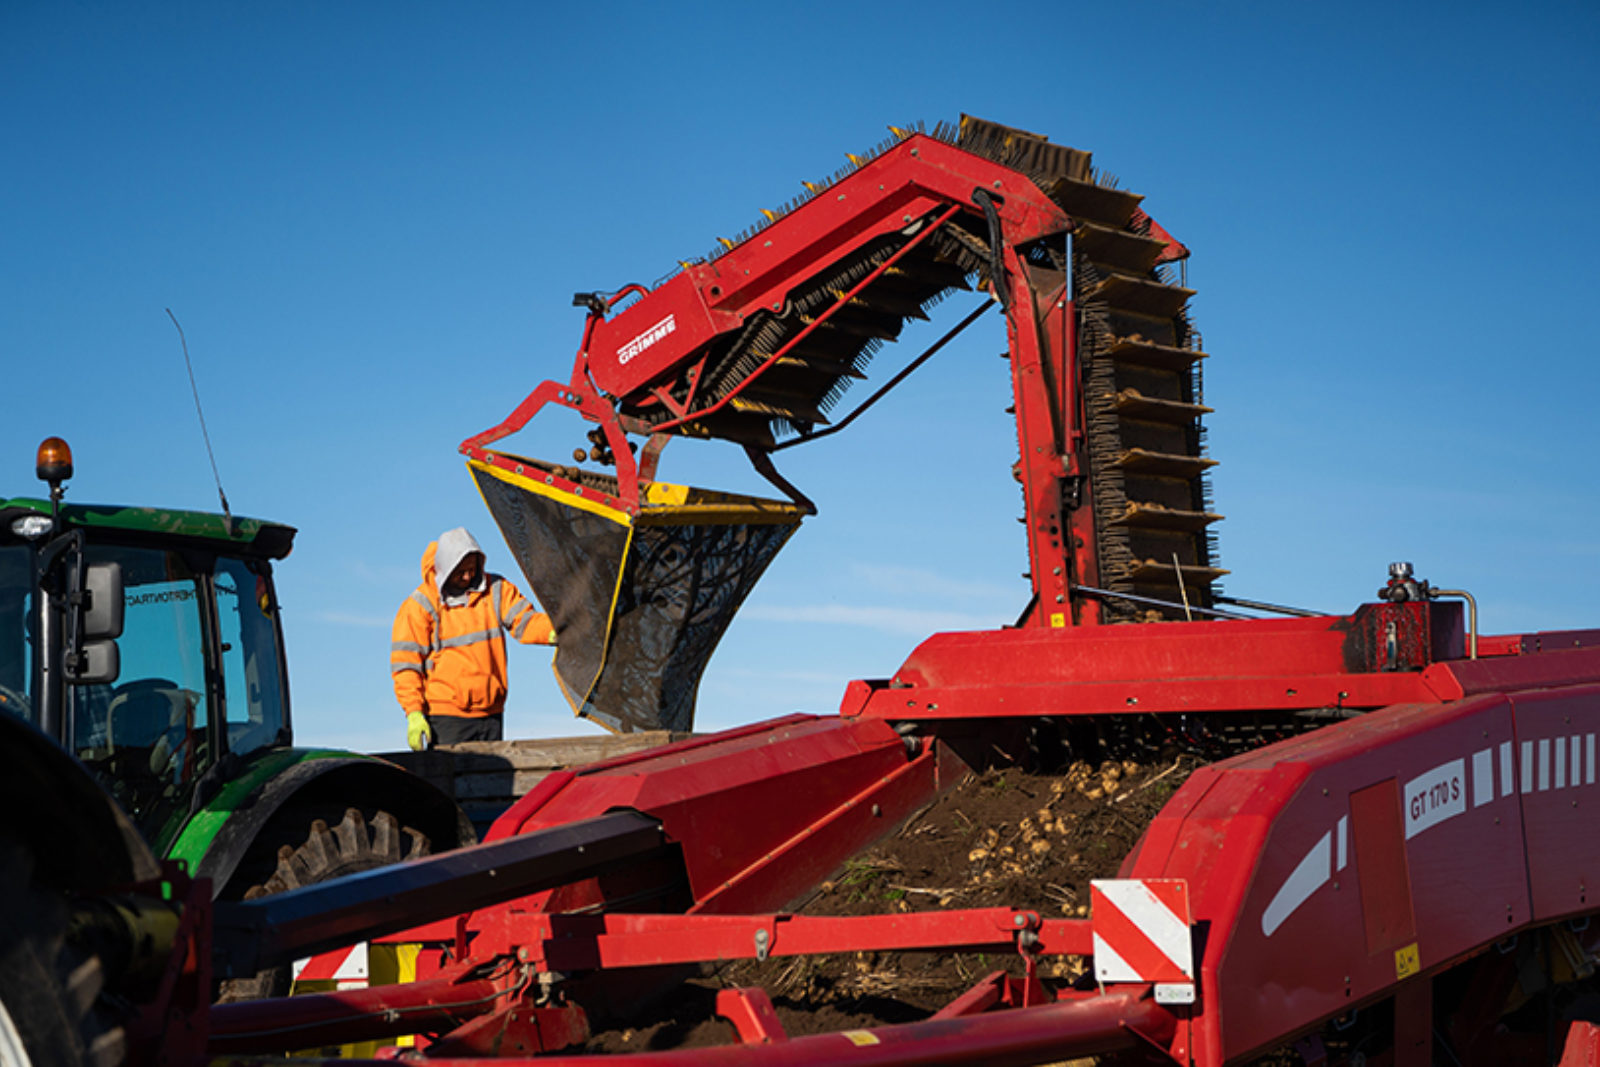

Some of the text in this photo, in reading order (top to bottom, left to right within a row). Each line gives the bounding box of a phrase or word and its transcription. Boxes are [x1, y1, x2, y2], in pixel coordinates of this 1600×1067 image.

[618, 317, 676, 365] GRIMME
[1410, 776, 1460, 821] GT 170 S
